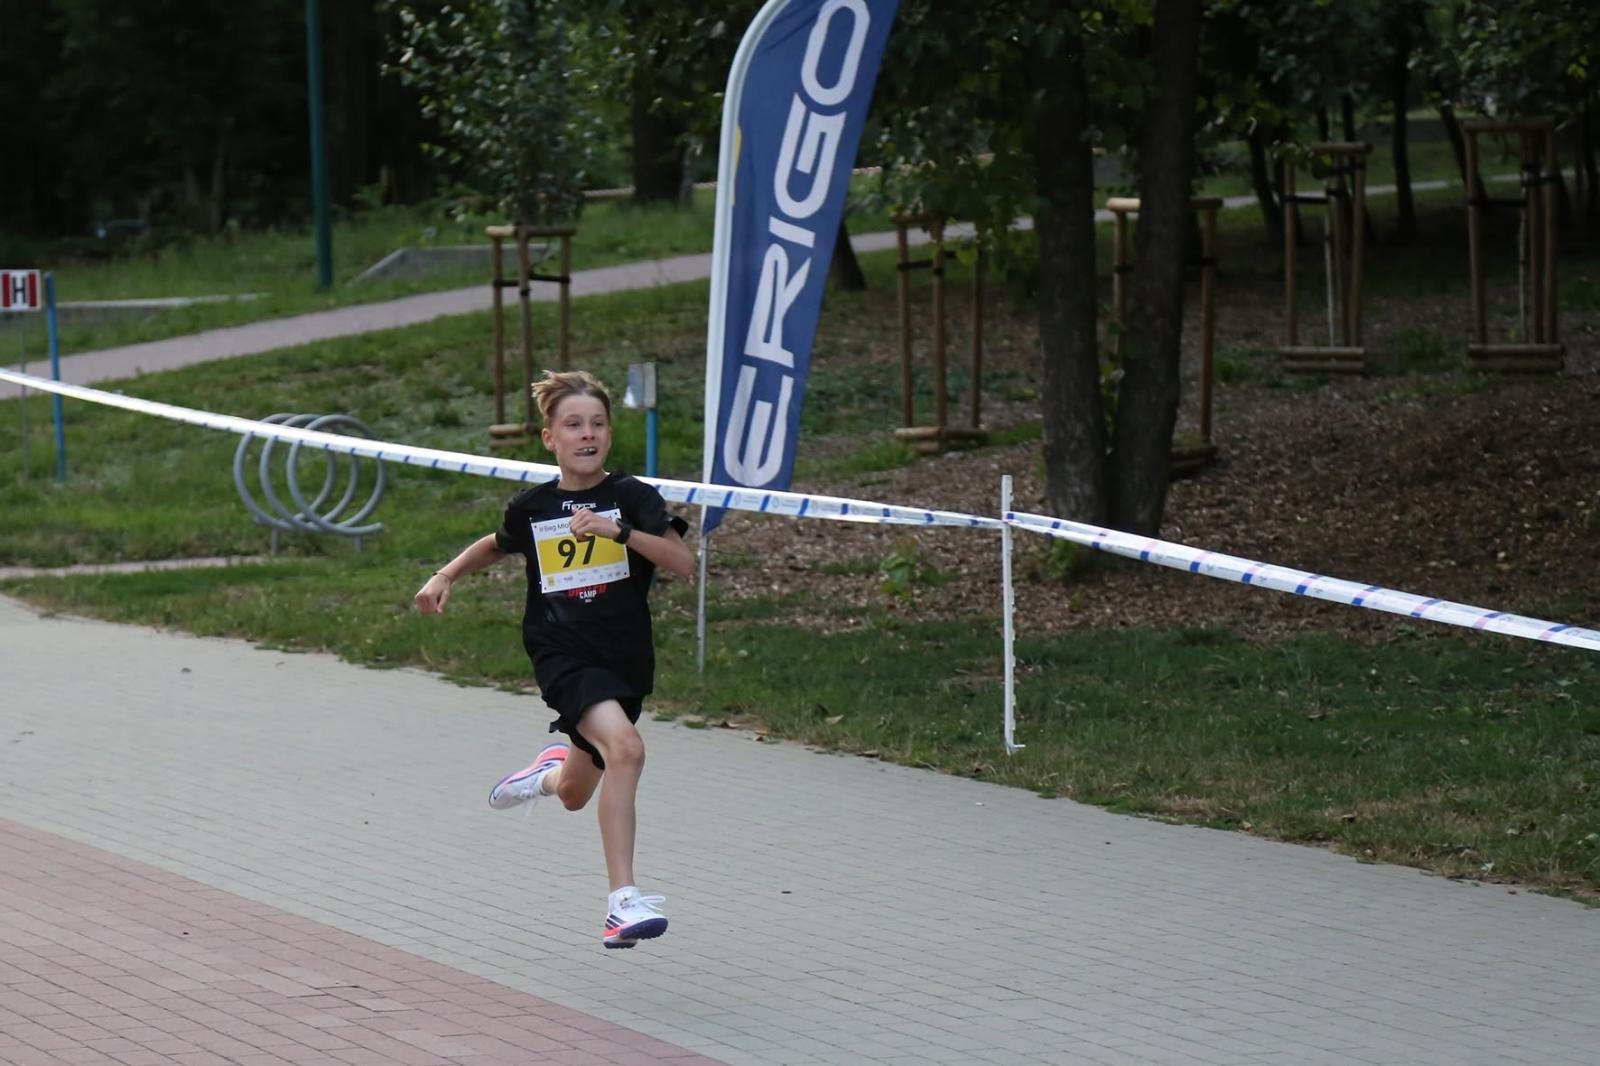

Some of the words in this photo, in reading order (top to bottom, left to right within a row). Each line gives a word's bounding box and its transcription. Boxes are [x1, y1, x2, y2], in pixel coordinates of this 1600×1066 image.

[724, 0, 870, 487] ERIGO
[12, 276, 26, 304] H
[558, 535, 595, 568] 97
[580, 589, 597, 599] CAMP
